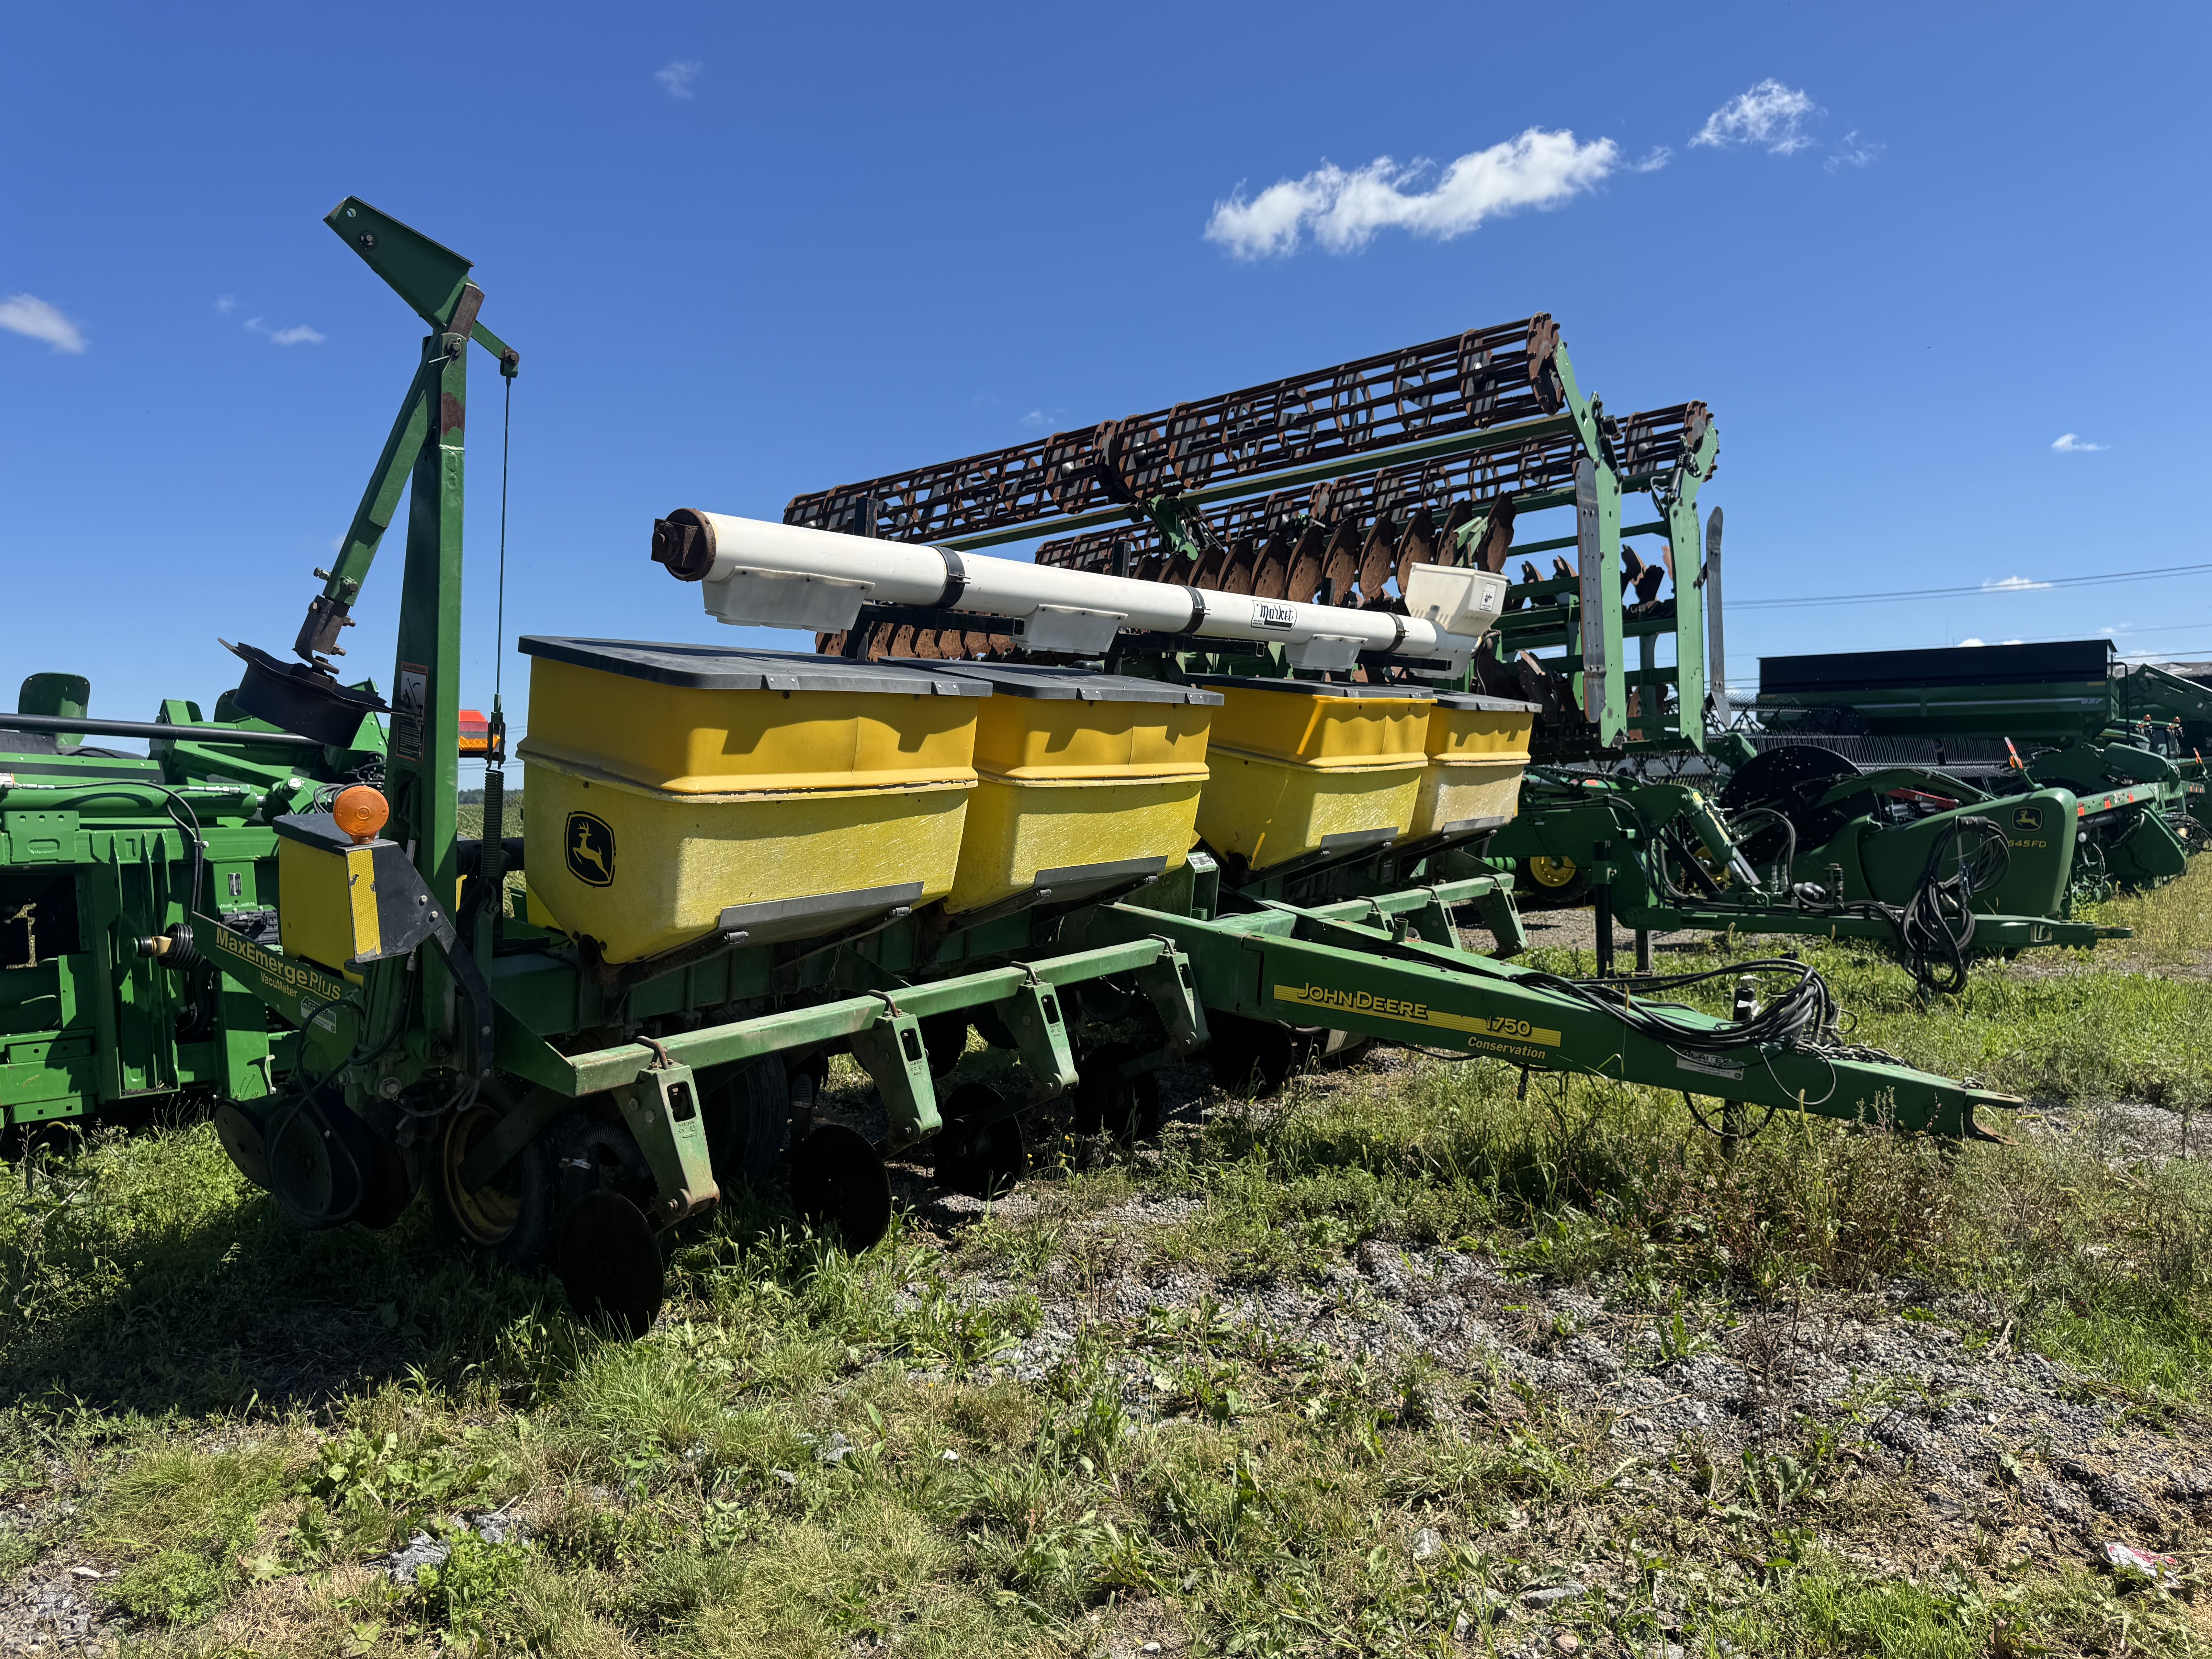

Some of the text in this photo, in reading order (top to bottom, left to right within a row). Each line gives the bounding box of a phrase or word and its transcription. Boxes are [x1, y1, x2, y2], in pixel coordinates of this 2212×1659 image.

[1256, 603, 1293, 622] Market
[260, 971, 298, 998] VacuMeter
[1298, 982, 1428, 1019] JOHN DEERE
[1486, 1015, 1531, 1036] 1750
[1468, 1036, 1546, 1060] Conservation
